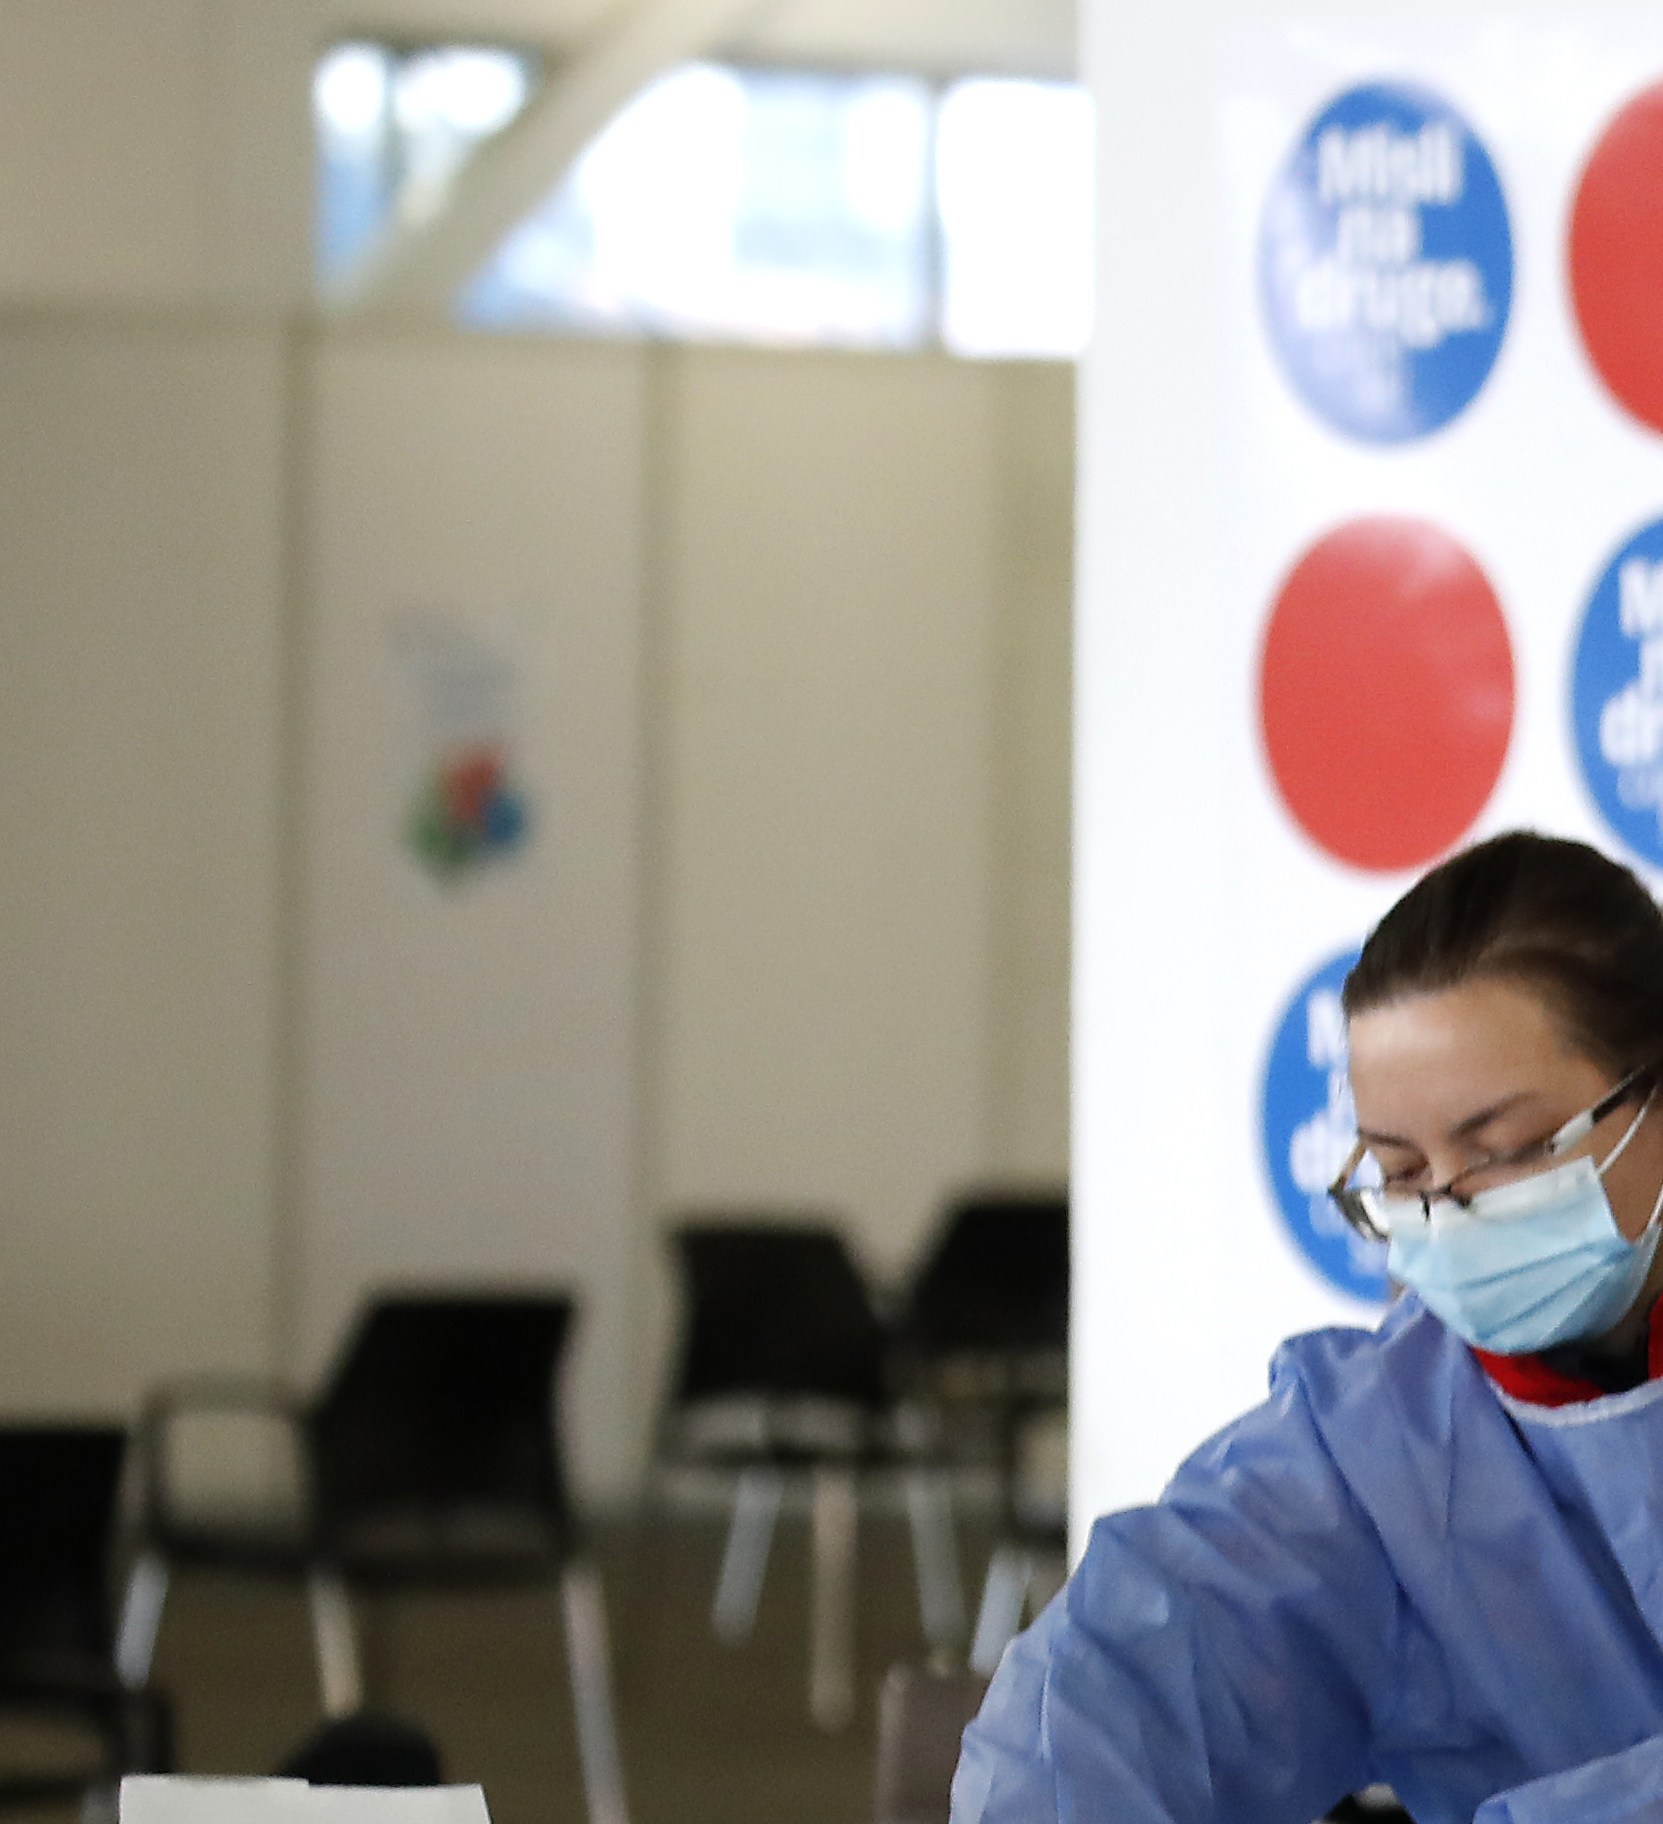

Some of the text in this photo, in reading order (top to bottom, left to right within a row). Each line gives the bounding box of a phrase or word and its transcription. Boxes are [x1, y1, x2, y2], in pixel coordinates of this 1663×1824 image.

[1318, 123, 1463, 203] Misli
[1338, 202, 1421, 263] na
[1297, 257, 1490, 349] druge.
